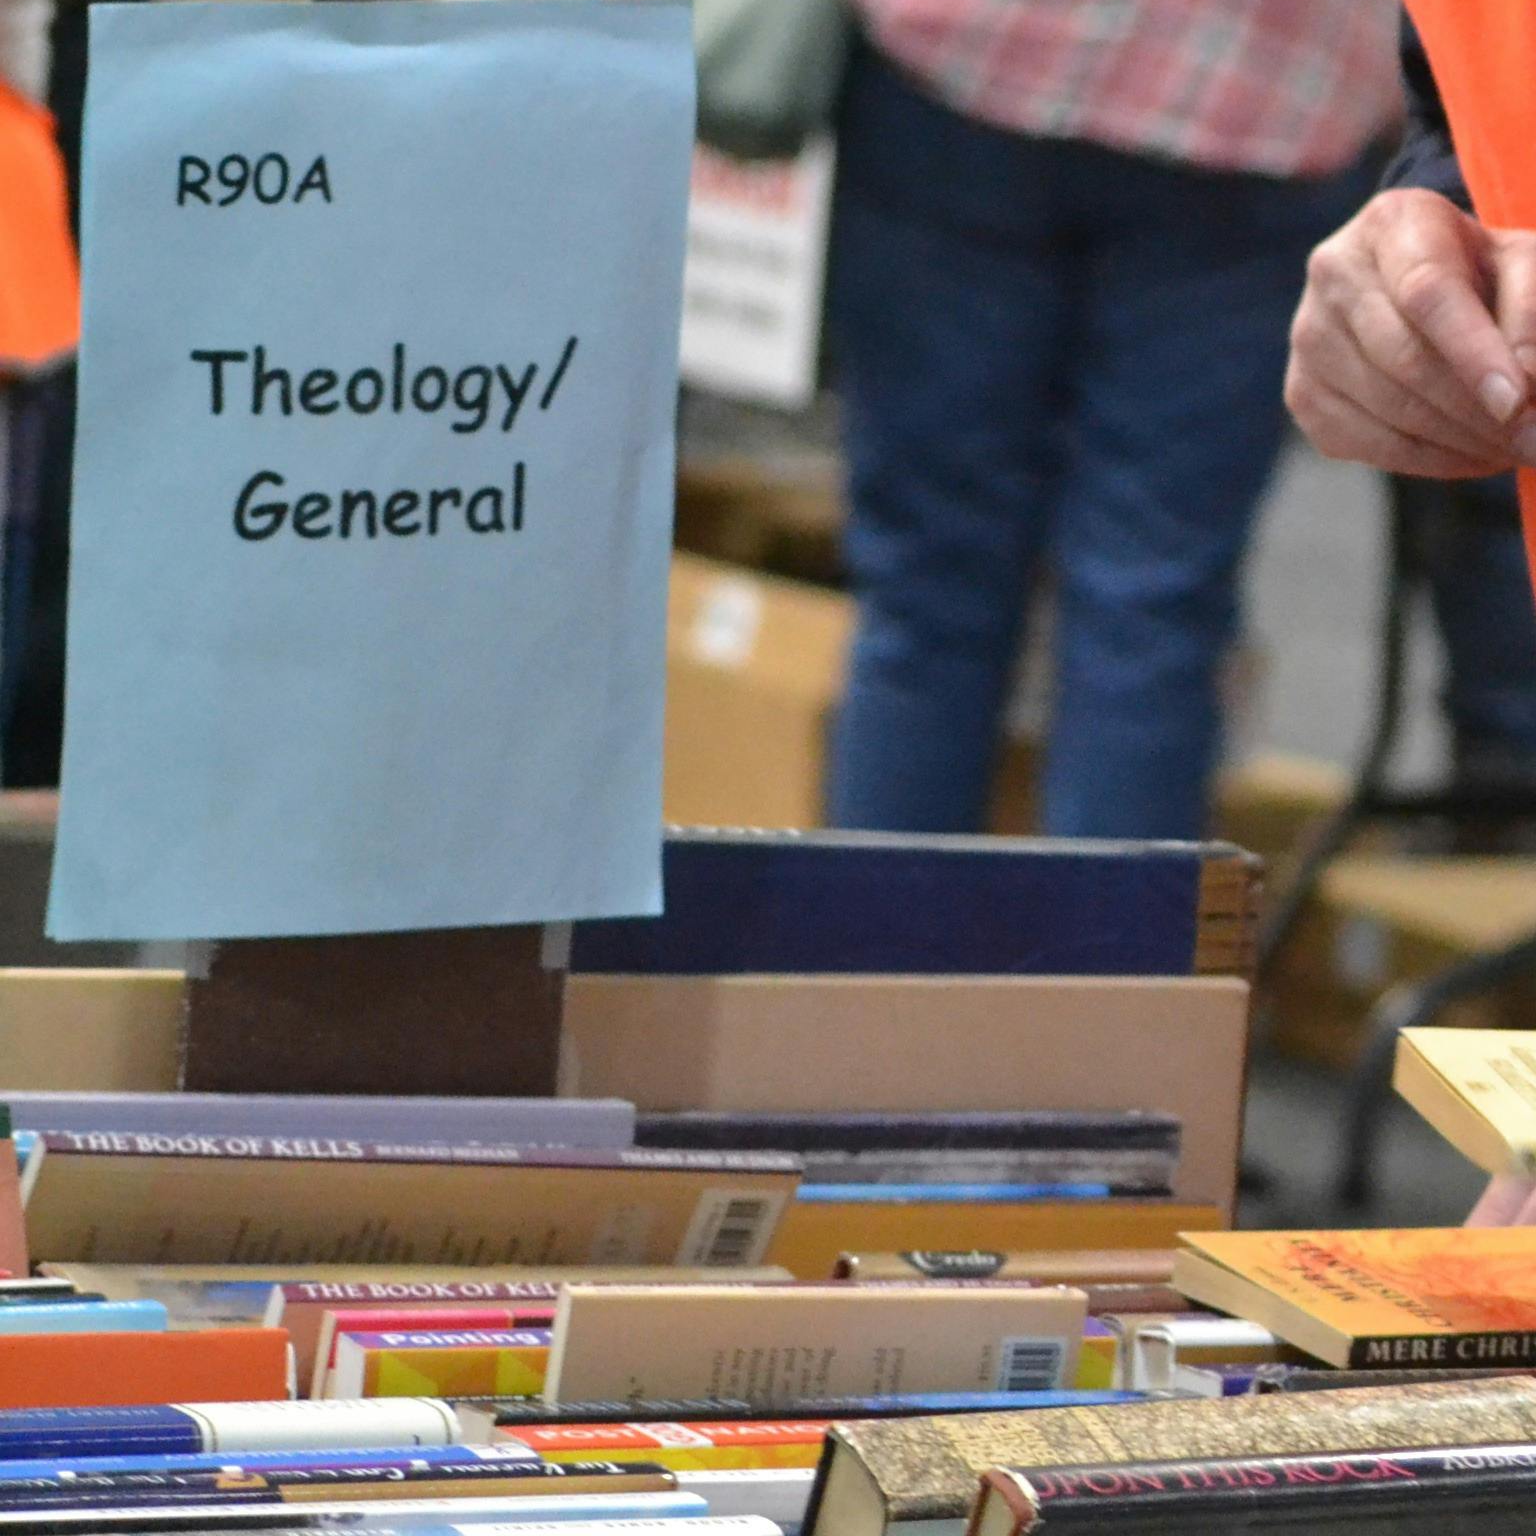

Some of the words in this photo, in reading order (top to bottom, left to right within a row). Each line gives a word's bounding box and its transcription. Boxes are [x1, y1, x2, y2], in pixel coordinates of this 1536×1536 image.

[176, 151, 334, 208] R90A
[190, 335, 578, 434] Theology/
[233, 461, 526, 542] General
[72, 1131, 131, 1152] THE
[135, 1133, 220, 1155] BOOK
[224, 1138, 264, 1157] OF
[271, 1138, 364, 1159] KELLS
[301, 1283, 364, 1300] THE
[368, 1282, 455, 1299] BOOK
[459, 1282, 499, 1298] OF
[505, 1281, 559, 1297] KEL
[379, 1330, 542, 1348] Pointing
[1366, 1336, 1447, 1363] MERE
[533, 1427, 637, 1442] POST
[701, 1421, 831, 1438] NATIO
[1177, 1463, 1277, 1490] THIS
[1283, 1458, 1416, 1483] ROCK
